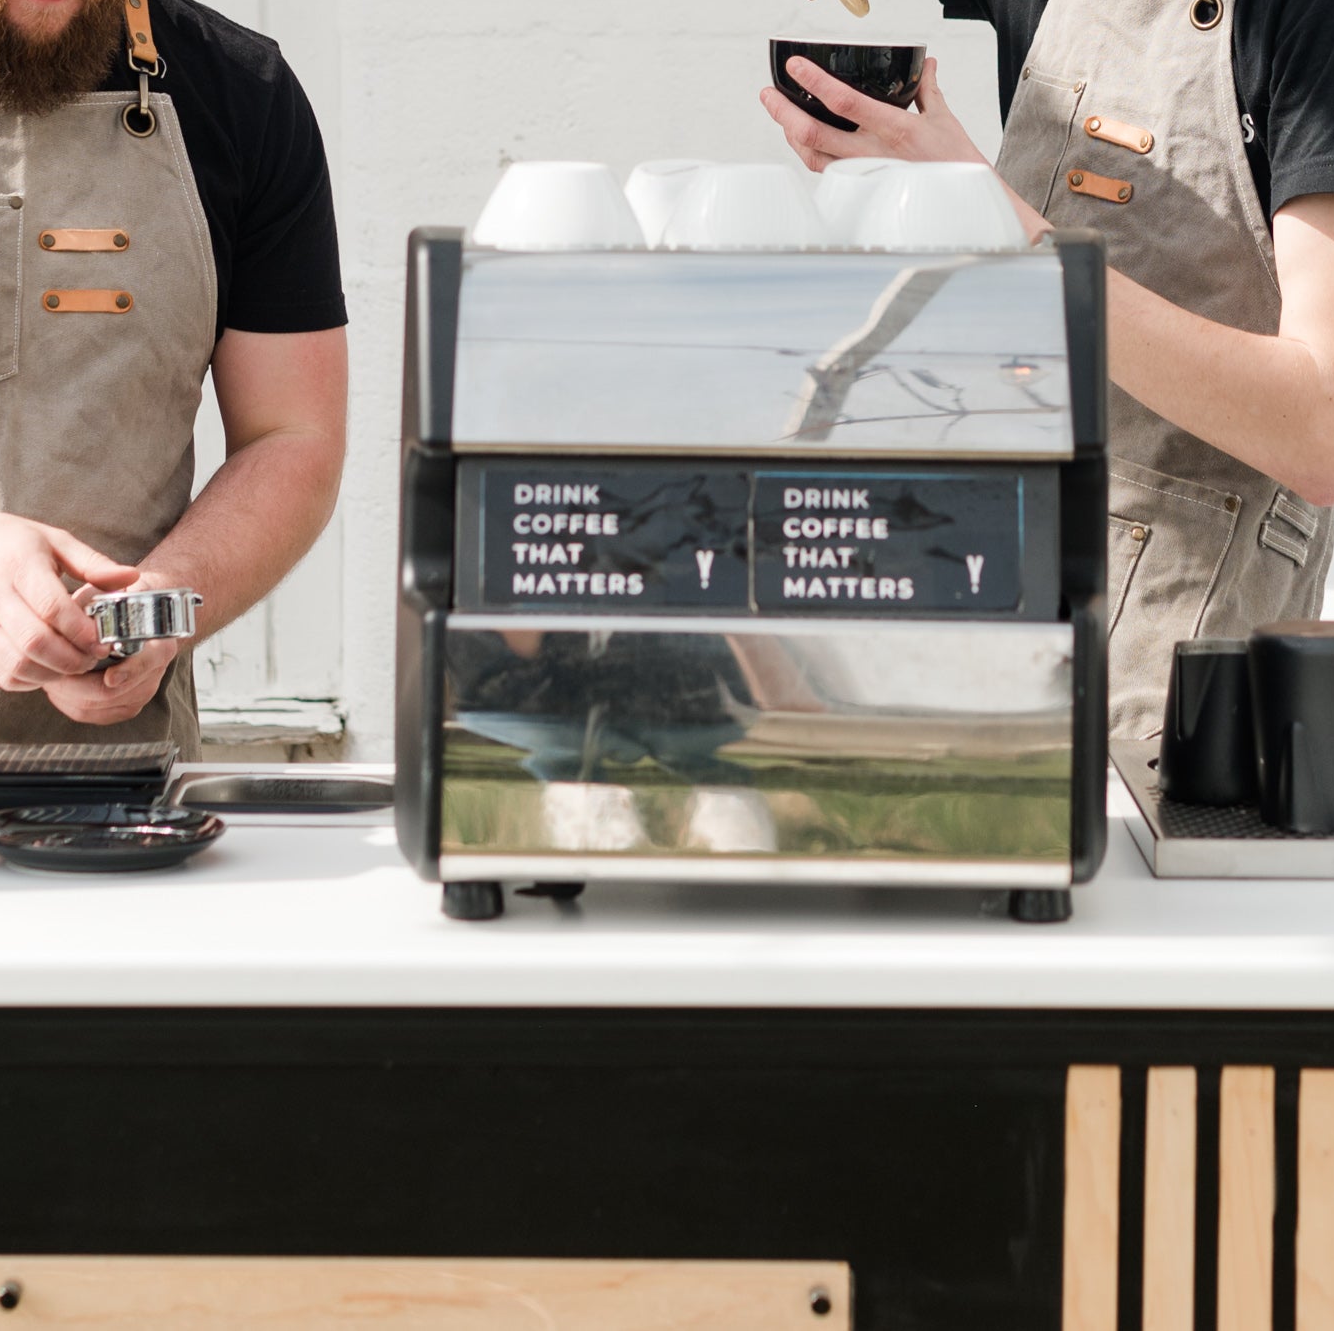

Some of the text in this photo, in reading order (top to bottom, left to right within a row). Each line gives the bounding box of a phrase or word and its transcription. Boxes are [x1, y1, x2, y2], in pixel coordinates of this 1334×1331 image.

[515, 485, 598, 504] DRINK
[785, 489, 868, 508] DRINK
[514, 514, 617, 534] COFFEE
[784, 518, 887, 538] COFFEE
[513, 544, 583, 563] THAT
[784, 547, 853, 567] THAT
[514, 574, 643, 594] MATTERS
[784, 578, 913, 599] MATTERS
